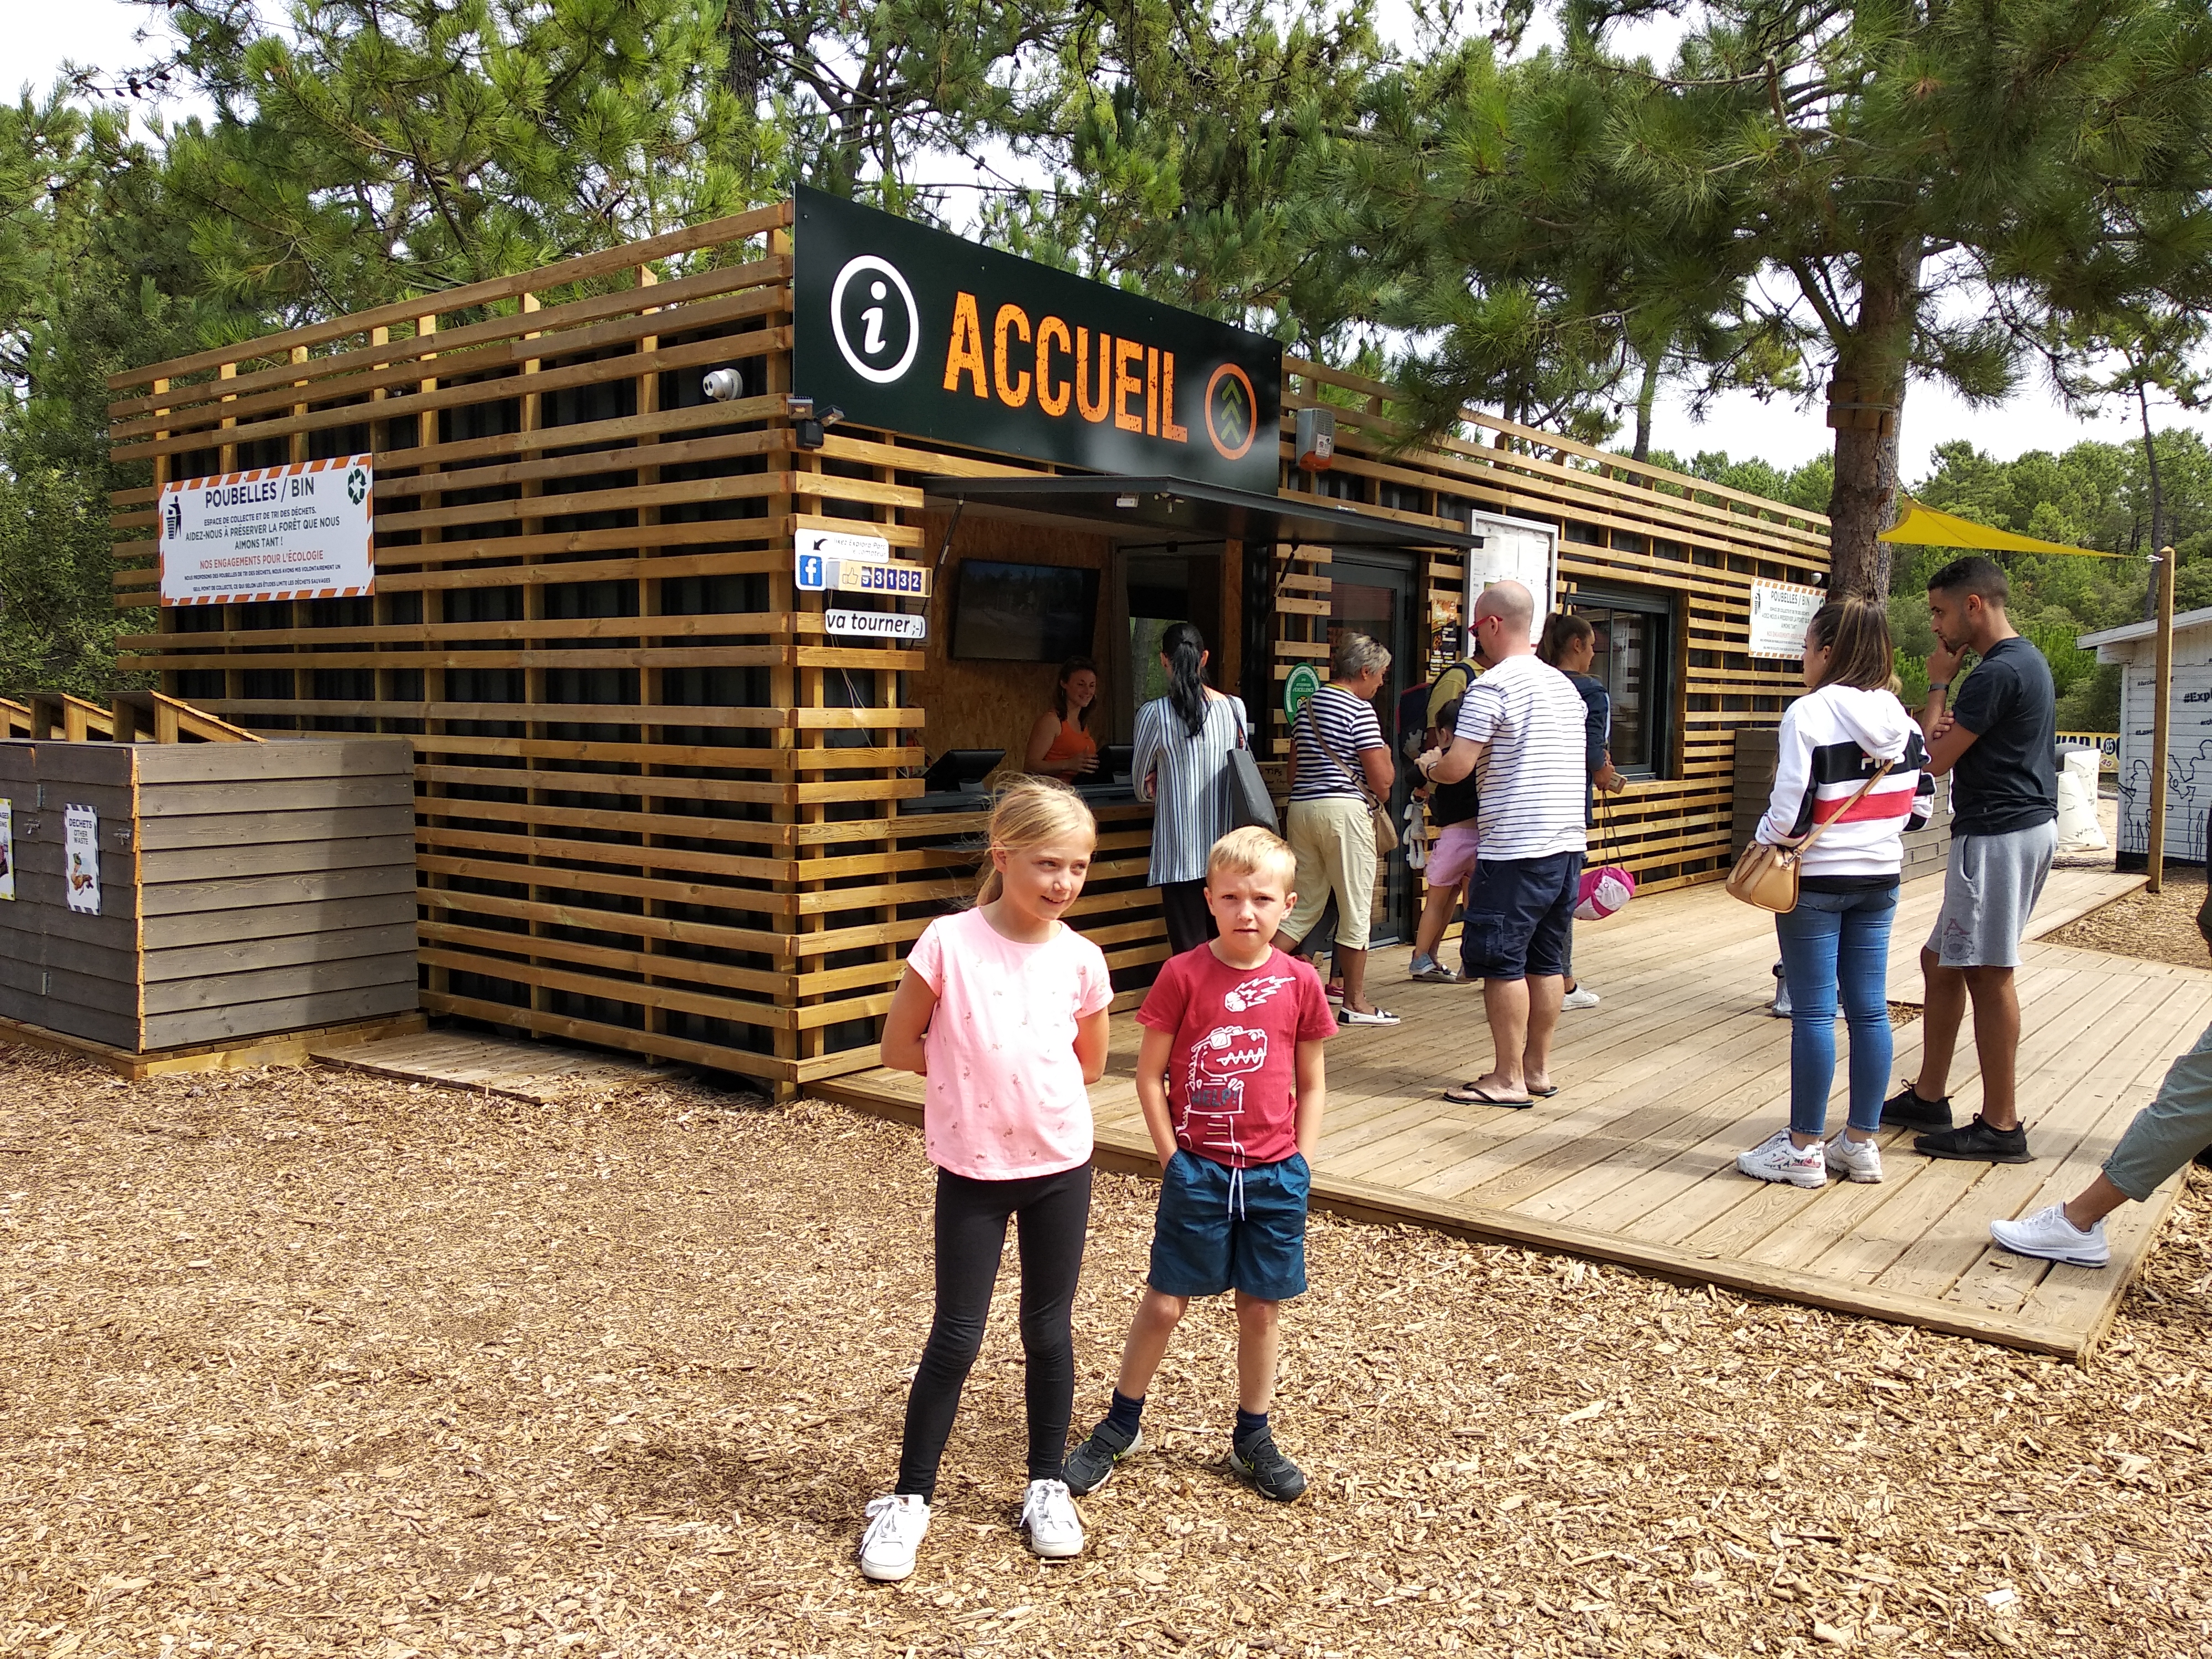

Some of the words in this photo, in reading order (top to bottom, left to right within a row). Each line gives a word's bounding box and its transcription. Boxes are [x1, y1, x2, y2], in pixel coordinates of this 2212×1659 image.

[943, 291, 1188, 443] ACCUEIL
[205, 482, 276, 508] POUBELLES
[291, 476, 314, 497] BIN
[185, 529, 222, 541] AIDEZ-NOUS
[269, 523, 277, 533] LA
[303, 519, 318, 529] QUE
[320, 516, 340, 528] NOUS
[204, 518, 222, 526] ESPACE
[230, 514, 254, 523] COLLECTE
[235, 539, 260, 550] AIMONS
[262, 536, 279, 548] TANT
[200, 560, 212, 569] NOS
[214, 555, 261, 568] ENGAGEMENTS
[263, 554, 281, 564] POUR
[1771, 590, 1798, 604] POUBELLES
[827, 614, 847, 629] va
[852, 613, 911, 633] tourner
[69, 818, 92, 828] DECHETS
[1192, 1087, 1238, 1107] HELP!
